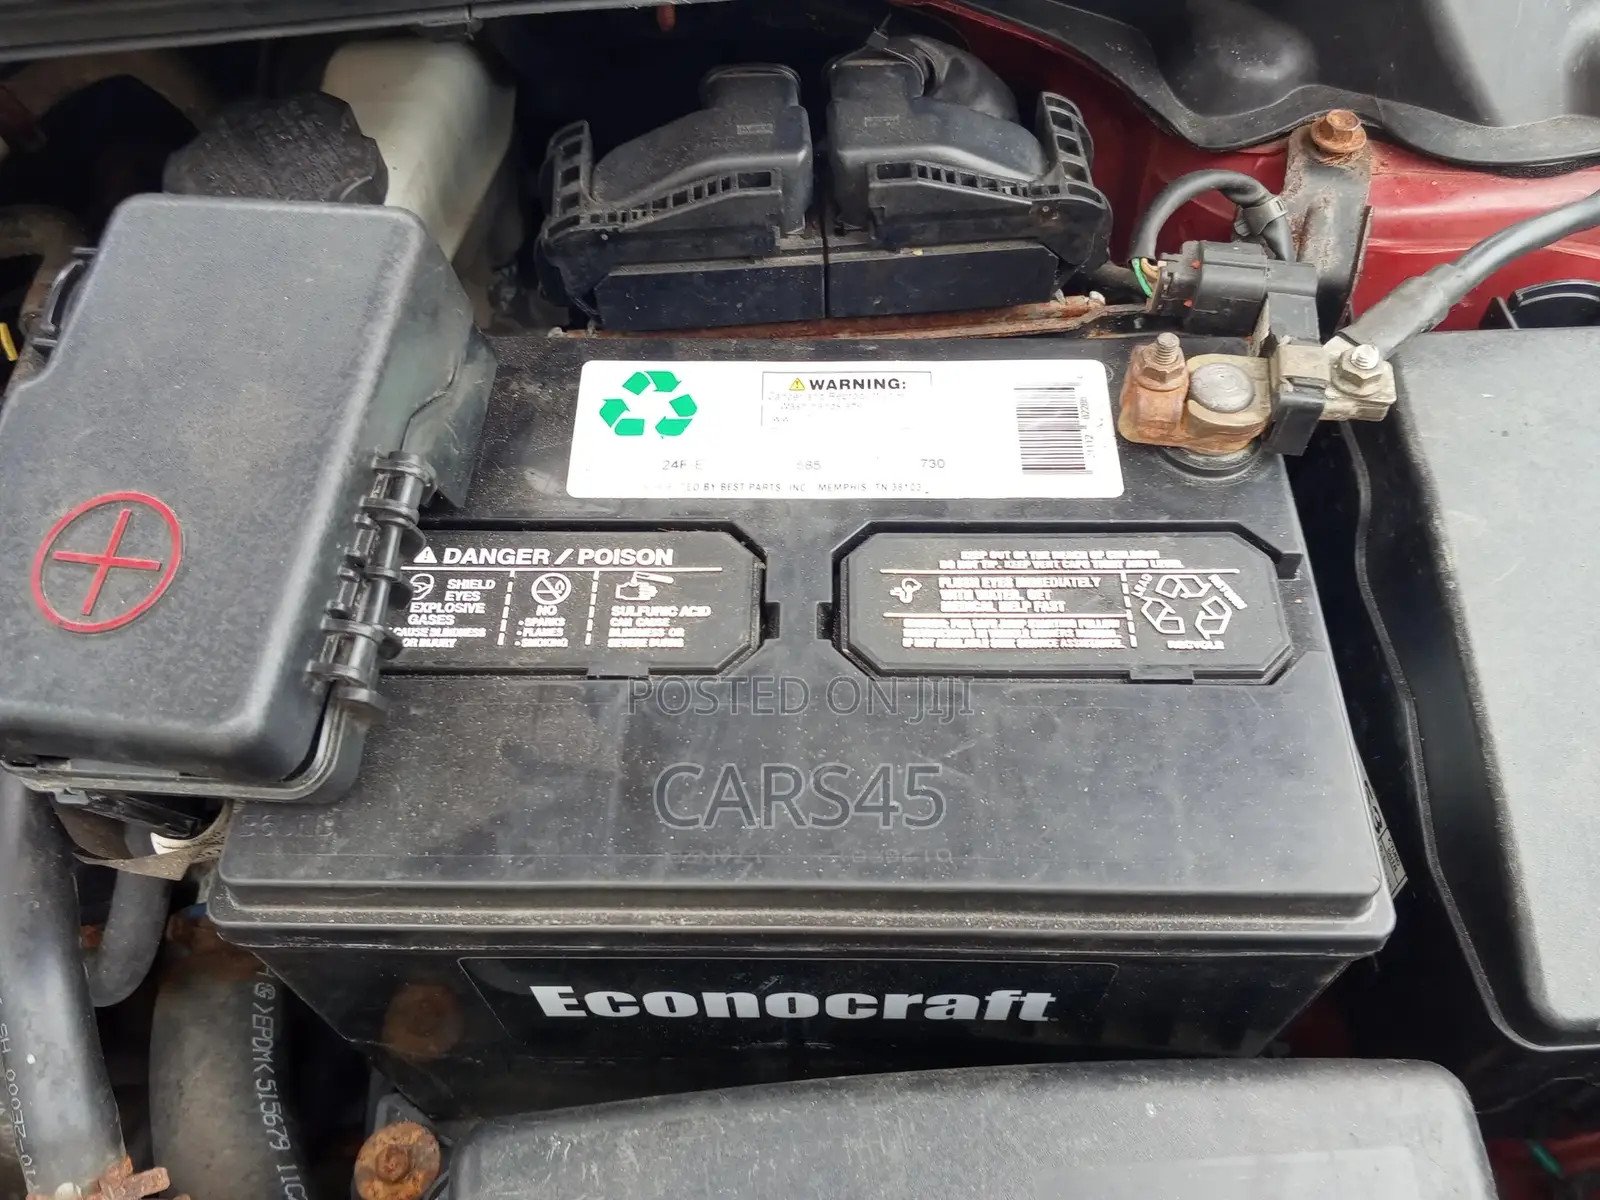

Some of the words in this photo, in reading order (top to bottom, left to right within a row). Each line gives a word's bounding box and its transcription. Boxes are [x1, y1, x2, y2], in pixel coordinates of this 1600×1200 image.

[808, 377, 907, 391] WARNING:
[920, 458, 946, 469] 730
[720, 482, 745, 492] BEST
[817, 483, 868, 492] MEMPHIS
[443, 548, 550, 566] DANGER
[577, 547, 675, 566] POISON
[446, 579, 496, 590] SHIELD
[444, 590, 481, 602] EYES
[409, 602, 486, 614] EXPLOSIVE
[536, 605, 558, 616] NO
[678, 605, 712, 617] ACID
[407, 613, 456, 626] GASES
[402, 638, 418, 648] OR
[529, 984, 1058, 1022] Econocraft
